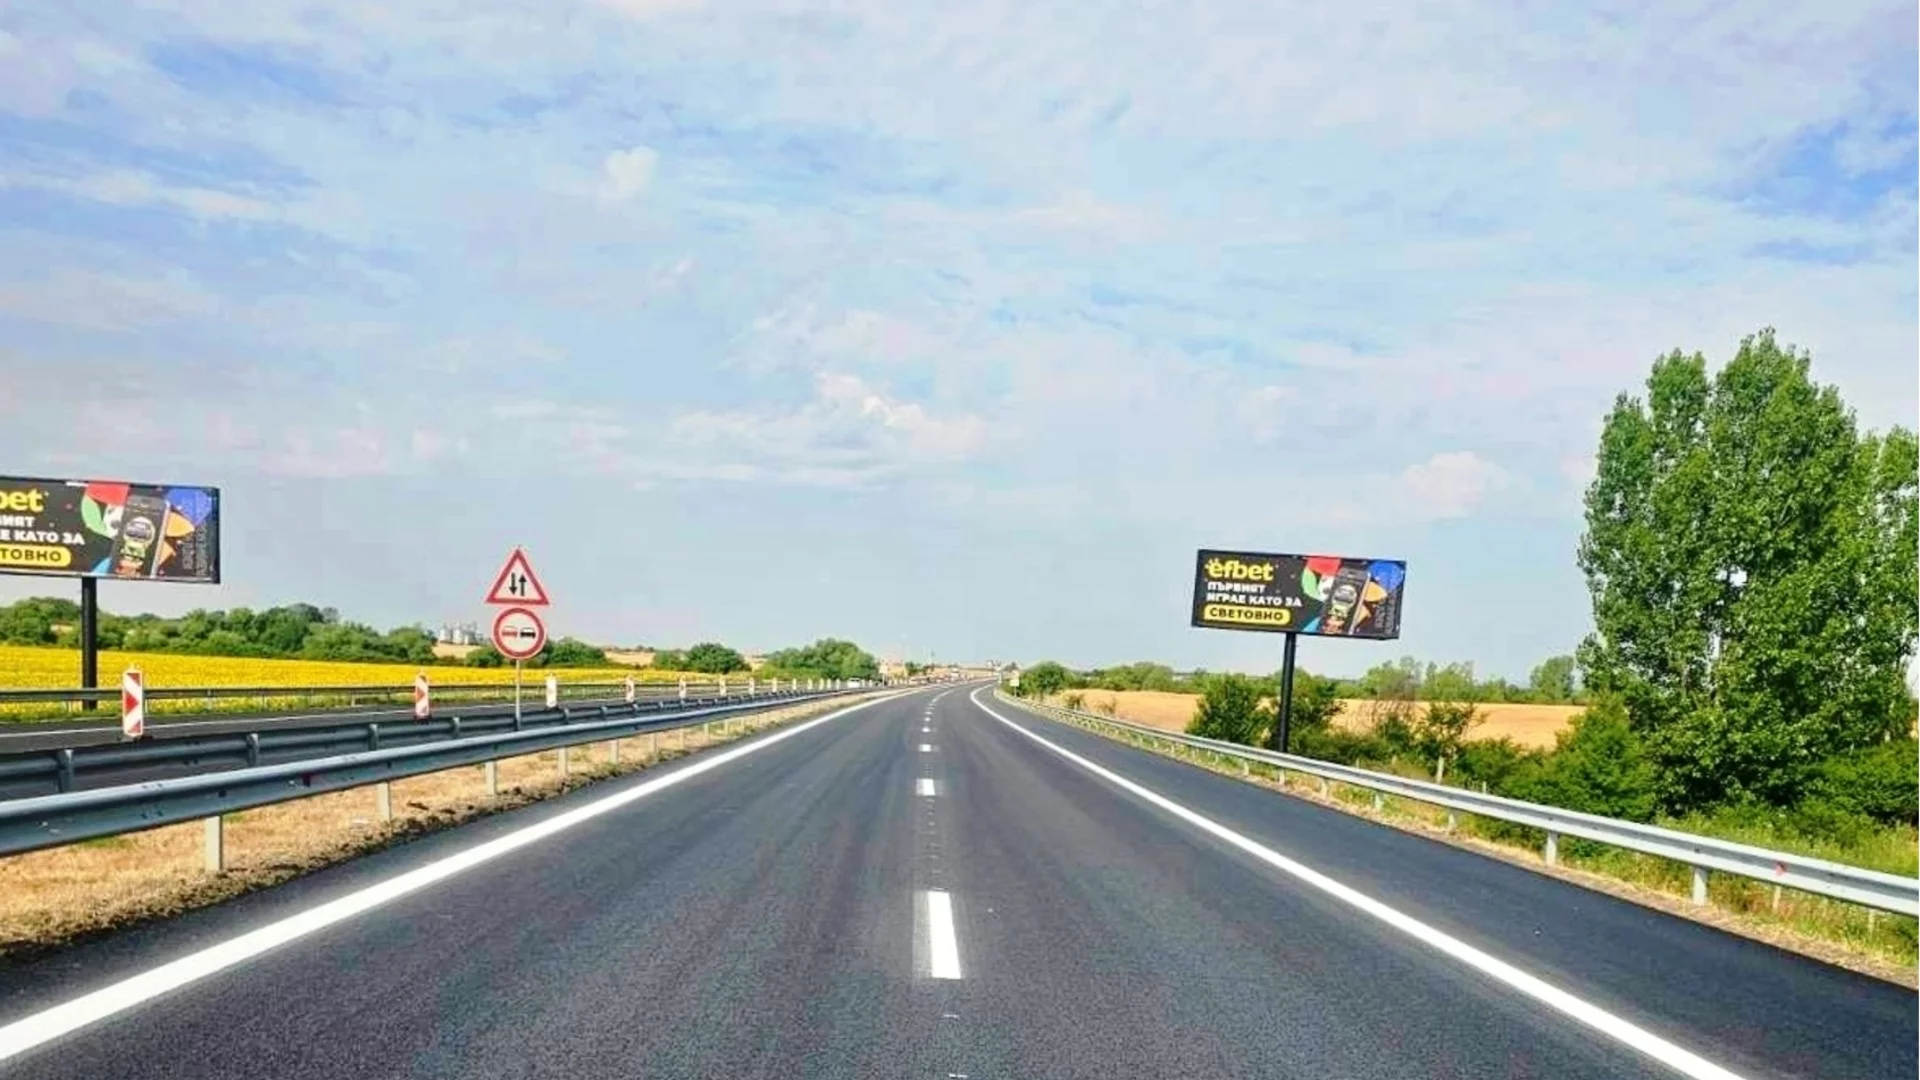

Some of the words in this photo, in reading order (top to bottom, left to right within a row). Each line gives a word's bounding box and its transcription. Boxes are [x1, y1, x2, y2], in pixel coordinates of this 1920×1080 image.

[0, 515, 35, 528] ИЯТ
[14, 530, 59, 543] КАТО
[62, 532, 86, 545] ЗА
[0, 548, 62, 562] ТОВНО
[1207, 560, 1274, 581] efbet
[1207, 581, 1266, 594] ПЪРВИЯТ
[1206, 592, 1246, 605] ИГРАЕ
[1249, 595, 1283, 606] КАТО
[1285, 597, 1302, 608] ЗА
[1209, 607, 1284, 621] СВЕТОВНО
